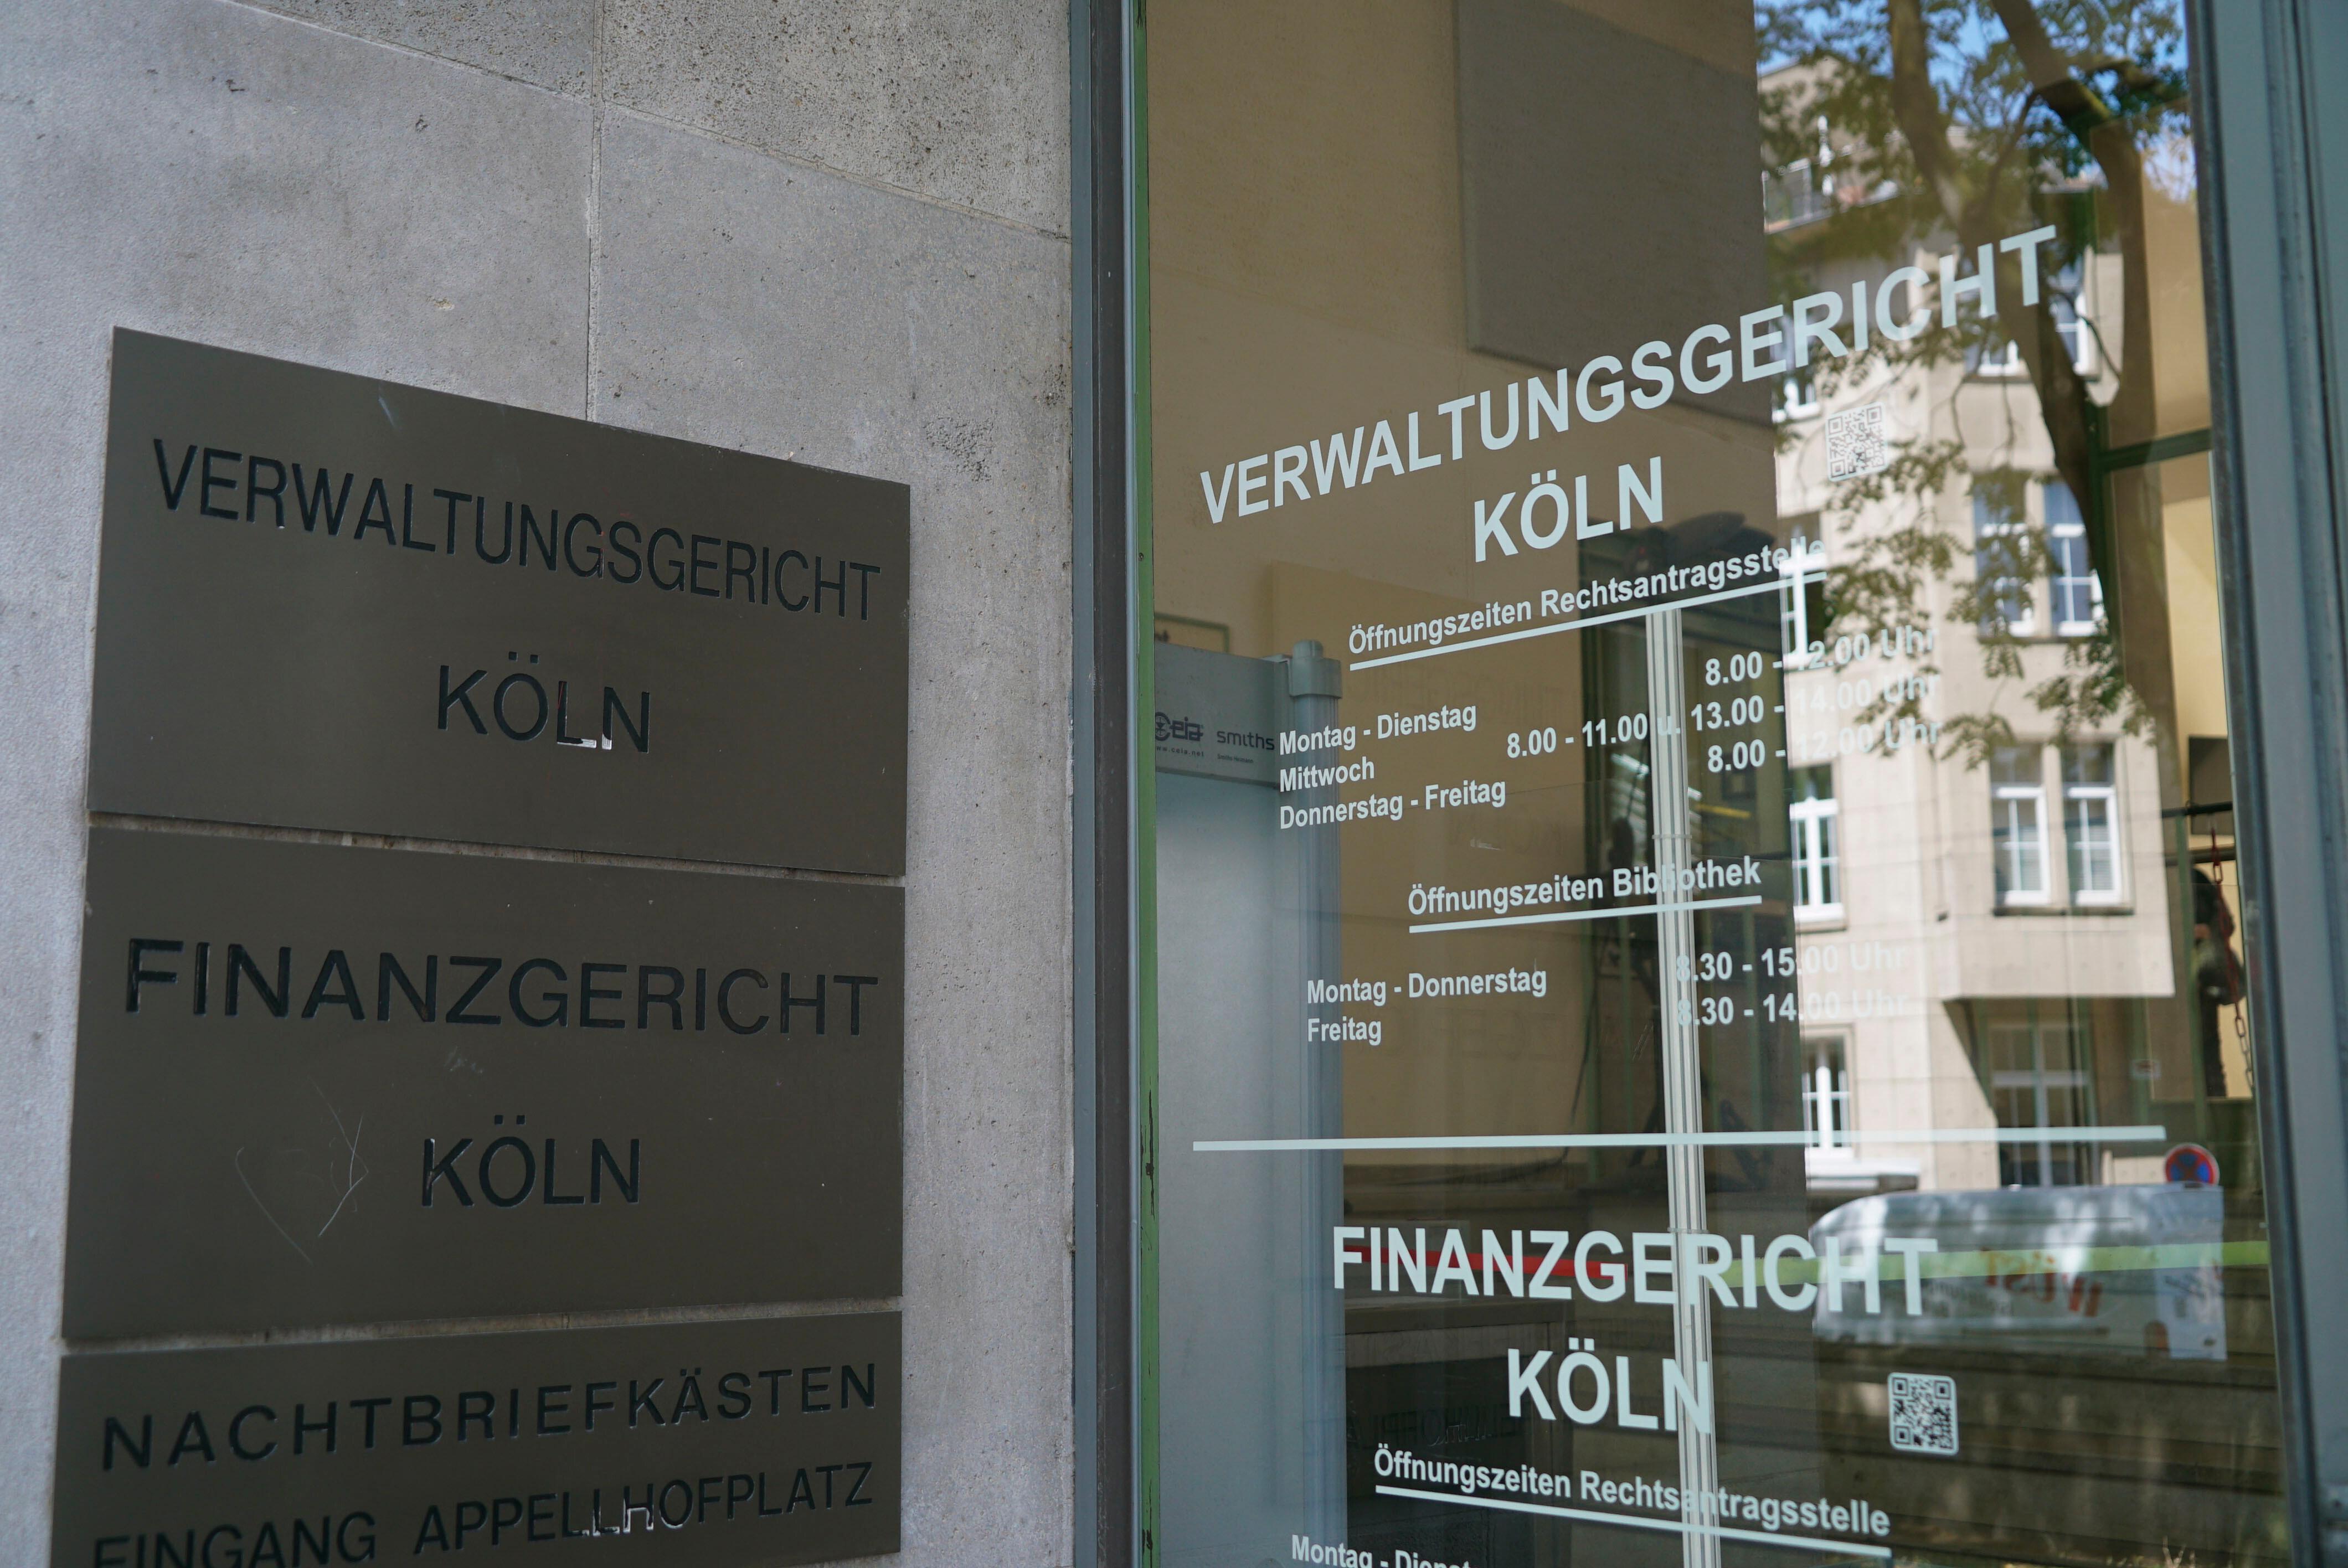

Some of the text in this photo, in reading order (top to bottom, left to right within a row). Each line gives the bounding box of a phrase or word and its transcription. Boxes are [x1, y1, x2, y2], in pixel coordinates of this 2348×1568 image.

[1200, 225, 2055, 524] VERWALTUNGSGERICHT
[153, 439, 882, 621] VERWALTUNGSGERICHT
[1474, 456, 1663, 563] KÖLN
[1350, 535, 1825, 654] Öffnungszeiten Rechtsantragsstelle
[437, 651, 650, 754] KÖLN
[1217, 731, 1275, 750] smiths
[1280, 725, 1356, 755] Montag
[1377, 705, 1476, 739] Dienstag
[1705, 651, 1763, 686] 8.00
[1882, 625, 1938, 658] Uhr
[1280, 756, 1374, 792] Mittwoch
[1507, 727, 1557, 759] 8.00
[1582, 713, 1647, 747] 11.00
[1691, 695, 1764, 731] 13.00
[1795, 679, 1872, 713] 14.00
[1883, 673, 1940, 704] Uhr
[1280, 793, 1403, 829] Donnerstag
[1425, 780, 1506, 810] Freitag
[1707, 739, 1765, 773] 8.00
[1885, 718, 1942, 749] Uhr
[1408, 855, 1761, 915] Öffnungszeiten Bibliothek
[125, 937, 879, 1036] FINANZGERICHT
[1307, 978, 1386, 1007] Montag
[1409, 967, 1546, 998] Donnerstag
[1676, 951, 1732, 982] 8.30
[1762, 945, 1839, 977] 15.00
[1308, 1016, 1381, 1046] Freitag
[1677, 996, 1734, 1027] 8.30
[422, 1114, 641, 1209] KÖLN
[1333, 1226, 1938, 1316] FINANZGERICHT
[102, 1363, 876, 1472] NACHTBRIEFKÄSTEN
[1508, 1337, 1712, 1434] KÖLN
[93, 1461, 874, 1568] EINGANG APPELLHOFPLATZ
[1374, 1443, 1888, 1534] Öffnungszeiten Rechtsantragsstelle
[1292, 1534, 1372, 1568] Montag
